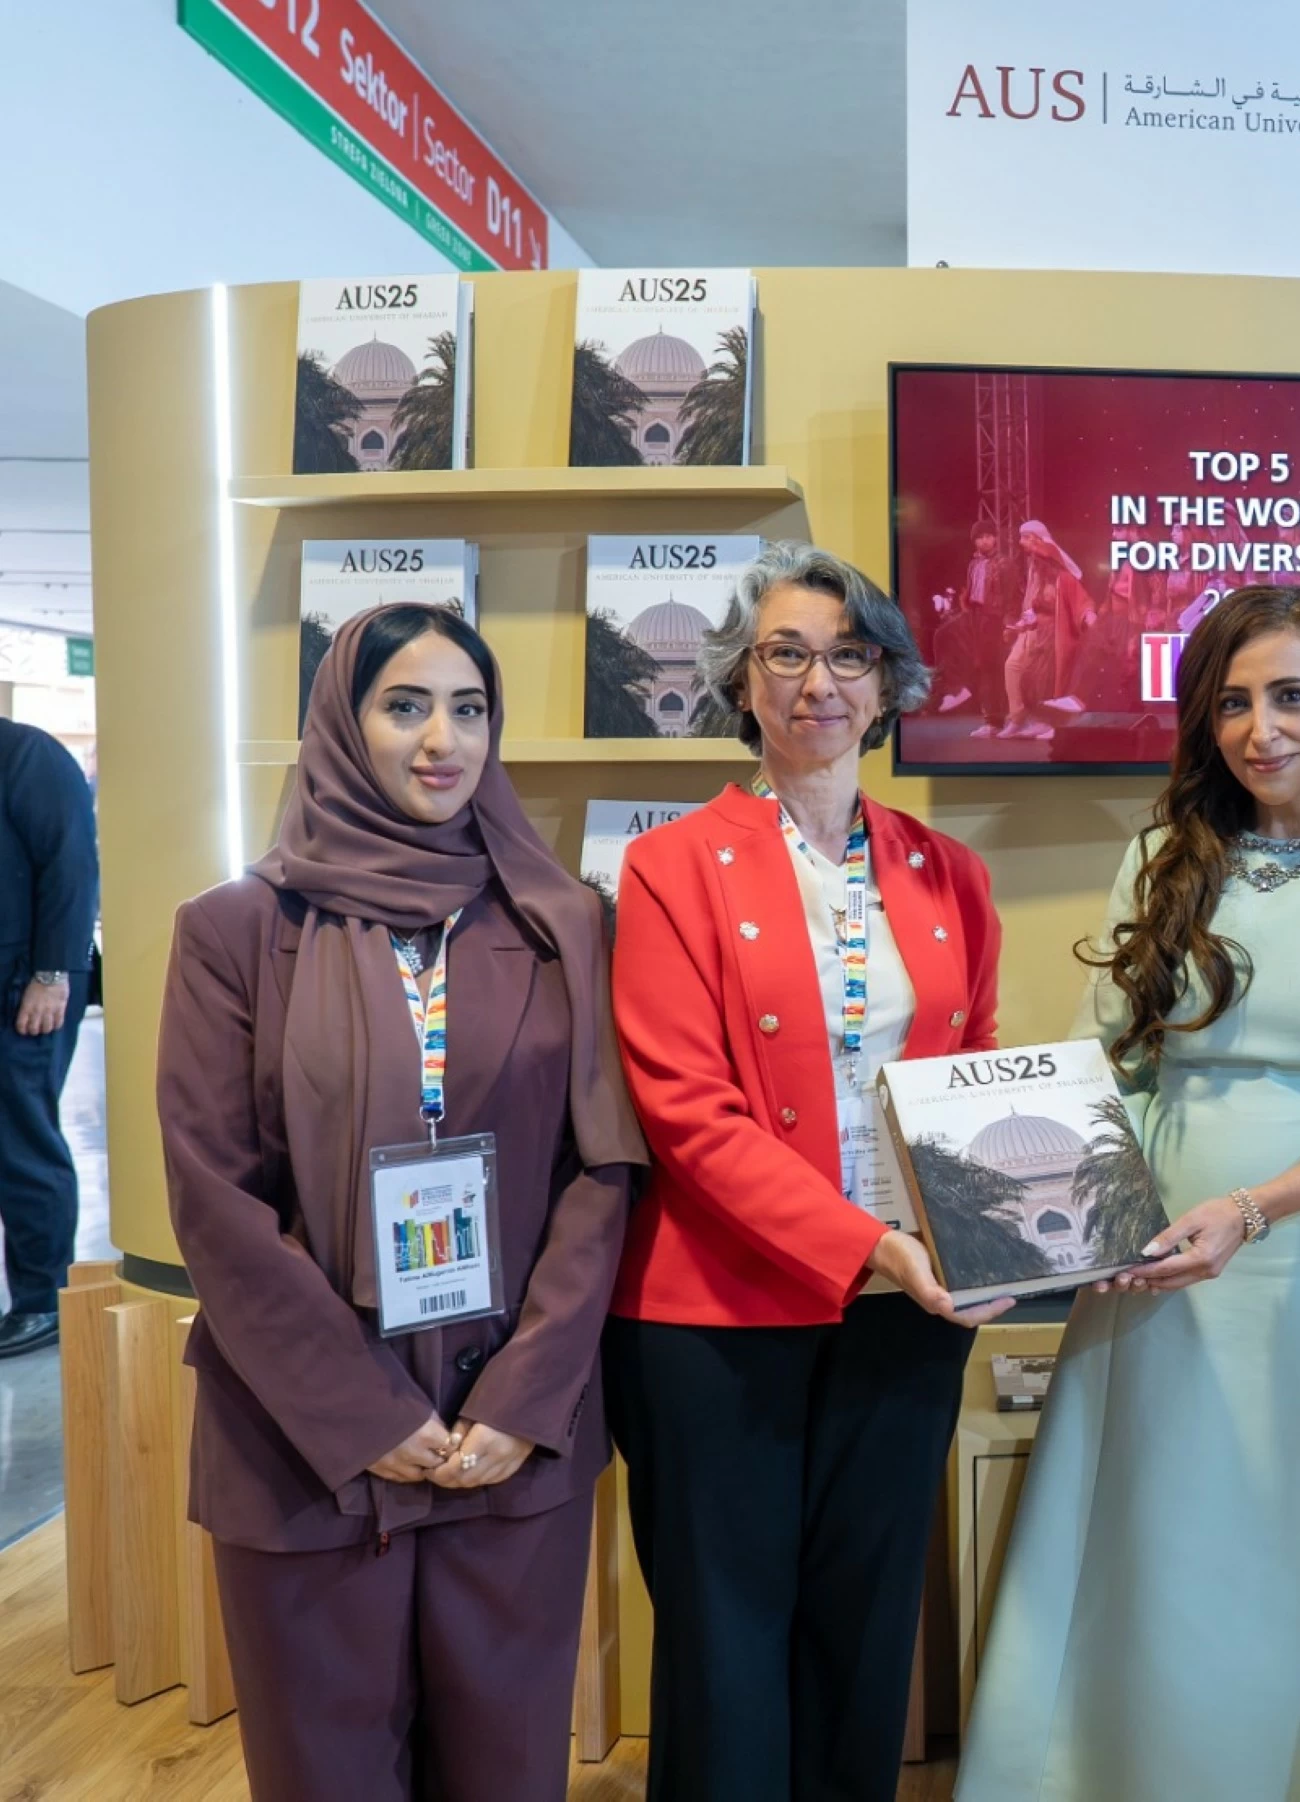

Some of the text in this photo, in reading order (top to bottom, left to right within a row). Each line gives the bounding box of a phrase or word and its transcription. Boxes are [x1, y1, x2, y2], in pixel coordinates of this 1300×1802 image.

[945, 64, 1086, 122] AUS
[1124, 74, 1226, 100] الشارقة
[1231, 81, 1264, 110] في
[1124, 107, 1237, 132] American
[340, 27, 523, 259] Sektor Sector D11
[335, 283, 418, 310] AUS25
[617, 277, 708, 303] AUS25
[1189, 451, 1289, 483] TOP 5
[1111, 495, 1146, 525] IN
[1157, 497, 1226, 527] THE
[339, 548, 425, 573] AUS25
[628, 544, 717, 570] AUS25
[1111, 541, 1180, 571] FOR
[947, 1053, 1057, 1089] AUS25
